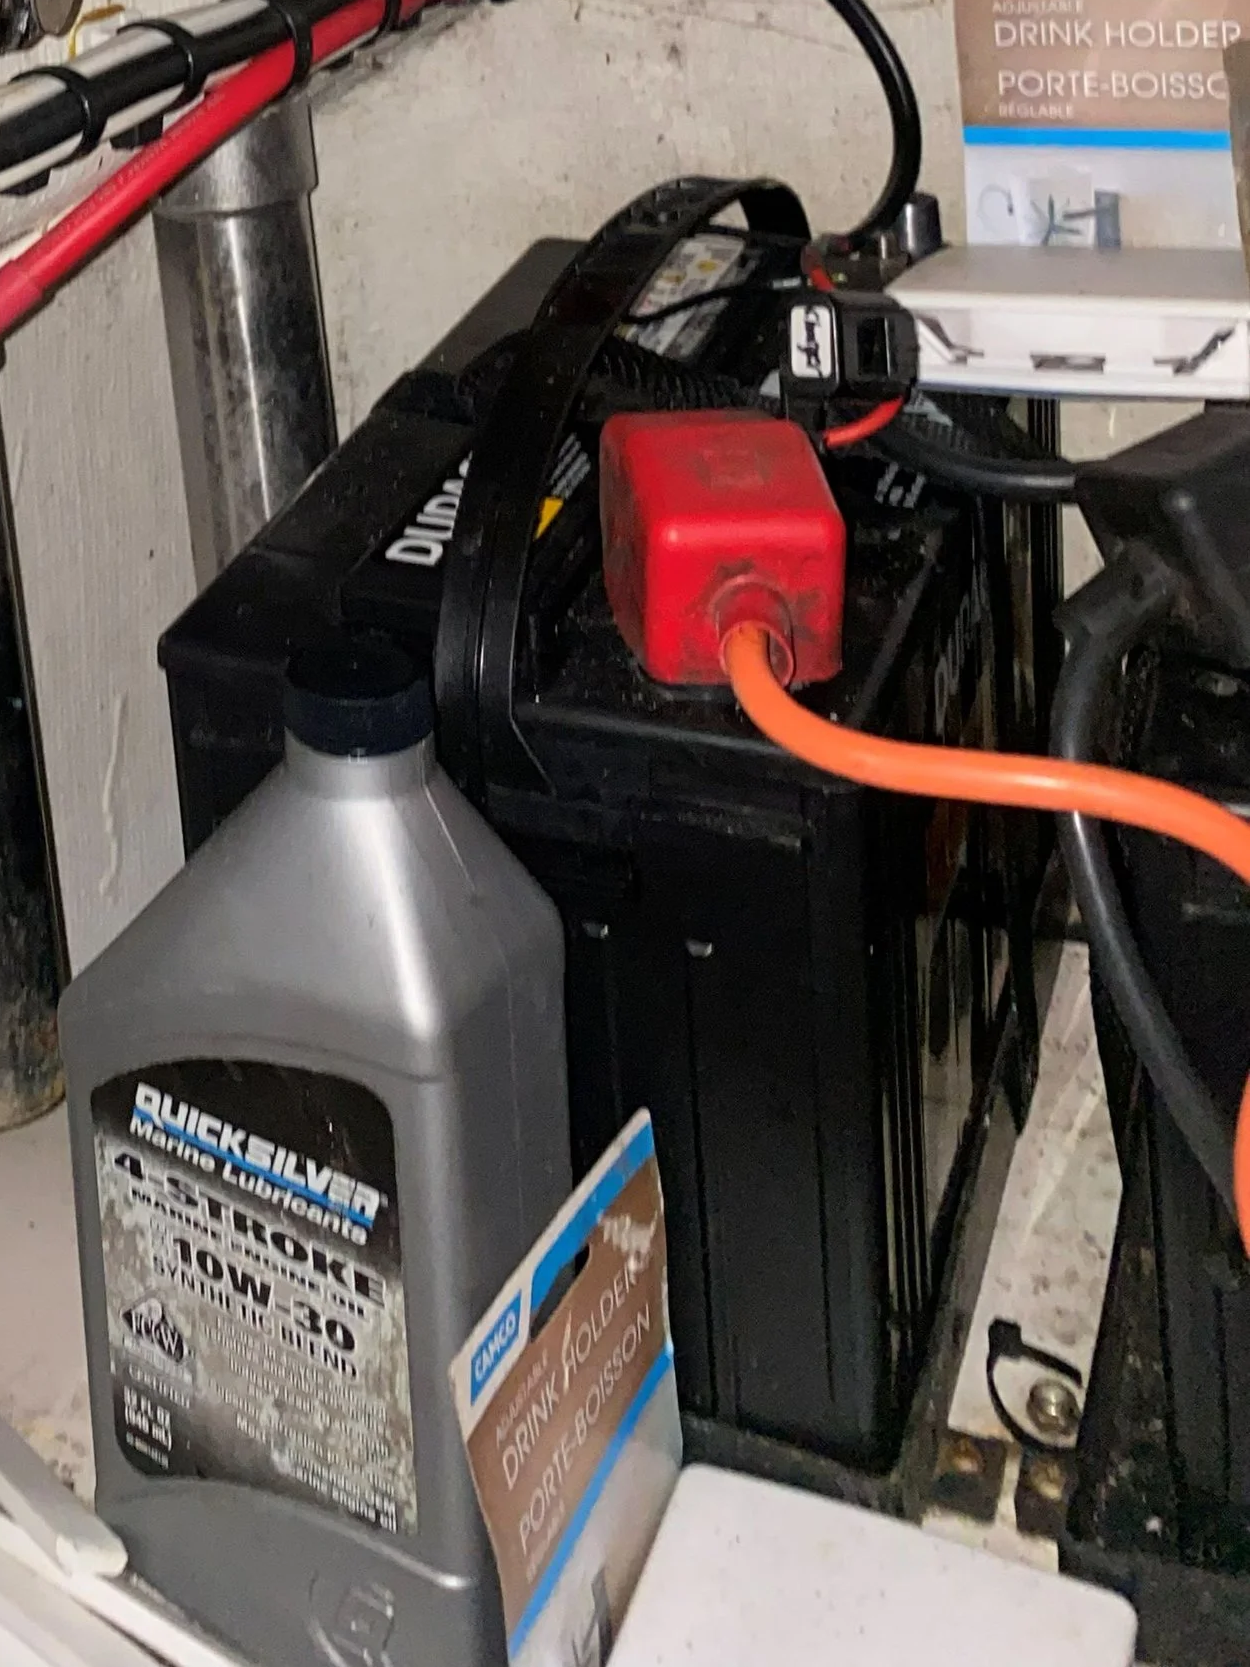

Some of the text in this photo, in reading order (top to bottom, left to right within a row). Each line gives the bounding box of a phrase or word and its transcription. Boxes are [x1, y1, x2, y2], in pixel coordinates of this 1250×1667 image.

[994, 19, 1094, 48] DRINK
[998, 69, 1229, 101] PORTE-BOISSO
[129, 1115, 216, 1174] Marine
[222, 1160, 369, 1247] Lubricants
[135, 1082, 381, 1224] QUICKSILVER
[113, 1152, 386, 1309] 4-STROKE
[173, 1237, 357, 1352] 10W-30
[473, 1307, 517, 1382] CAMCO
[502, 1371, 560, 1492] DRINK
[519, 1302, 651, 1555] PORTE-BOISSON
